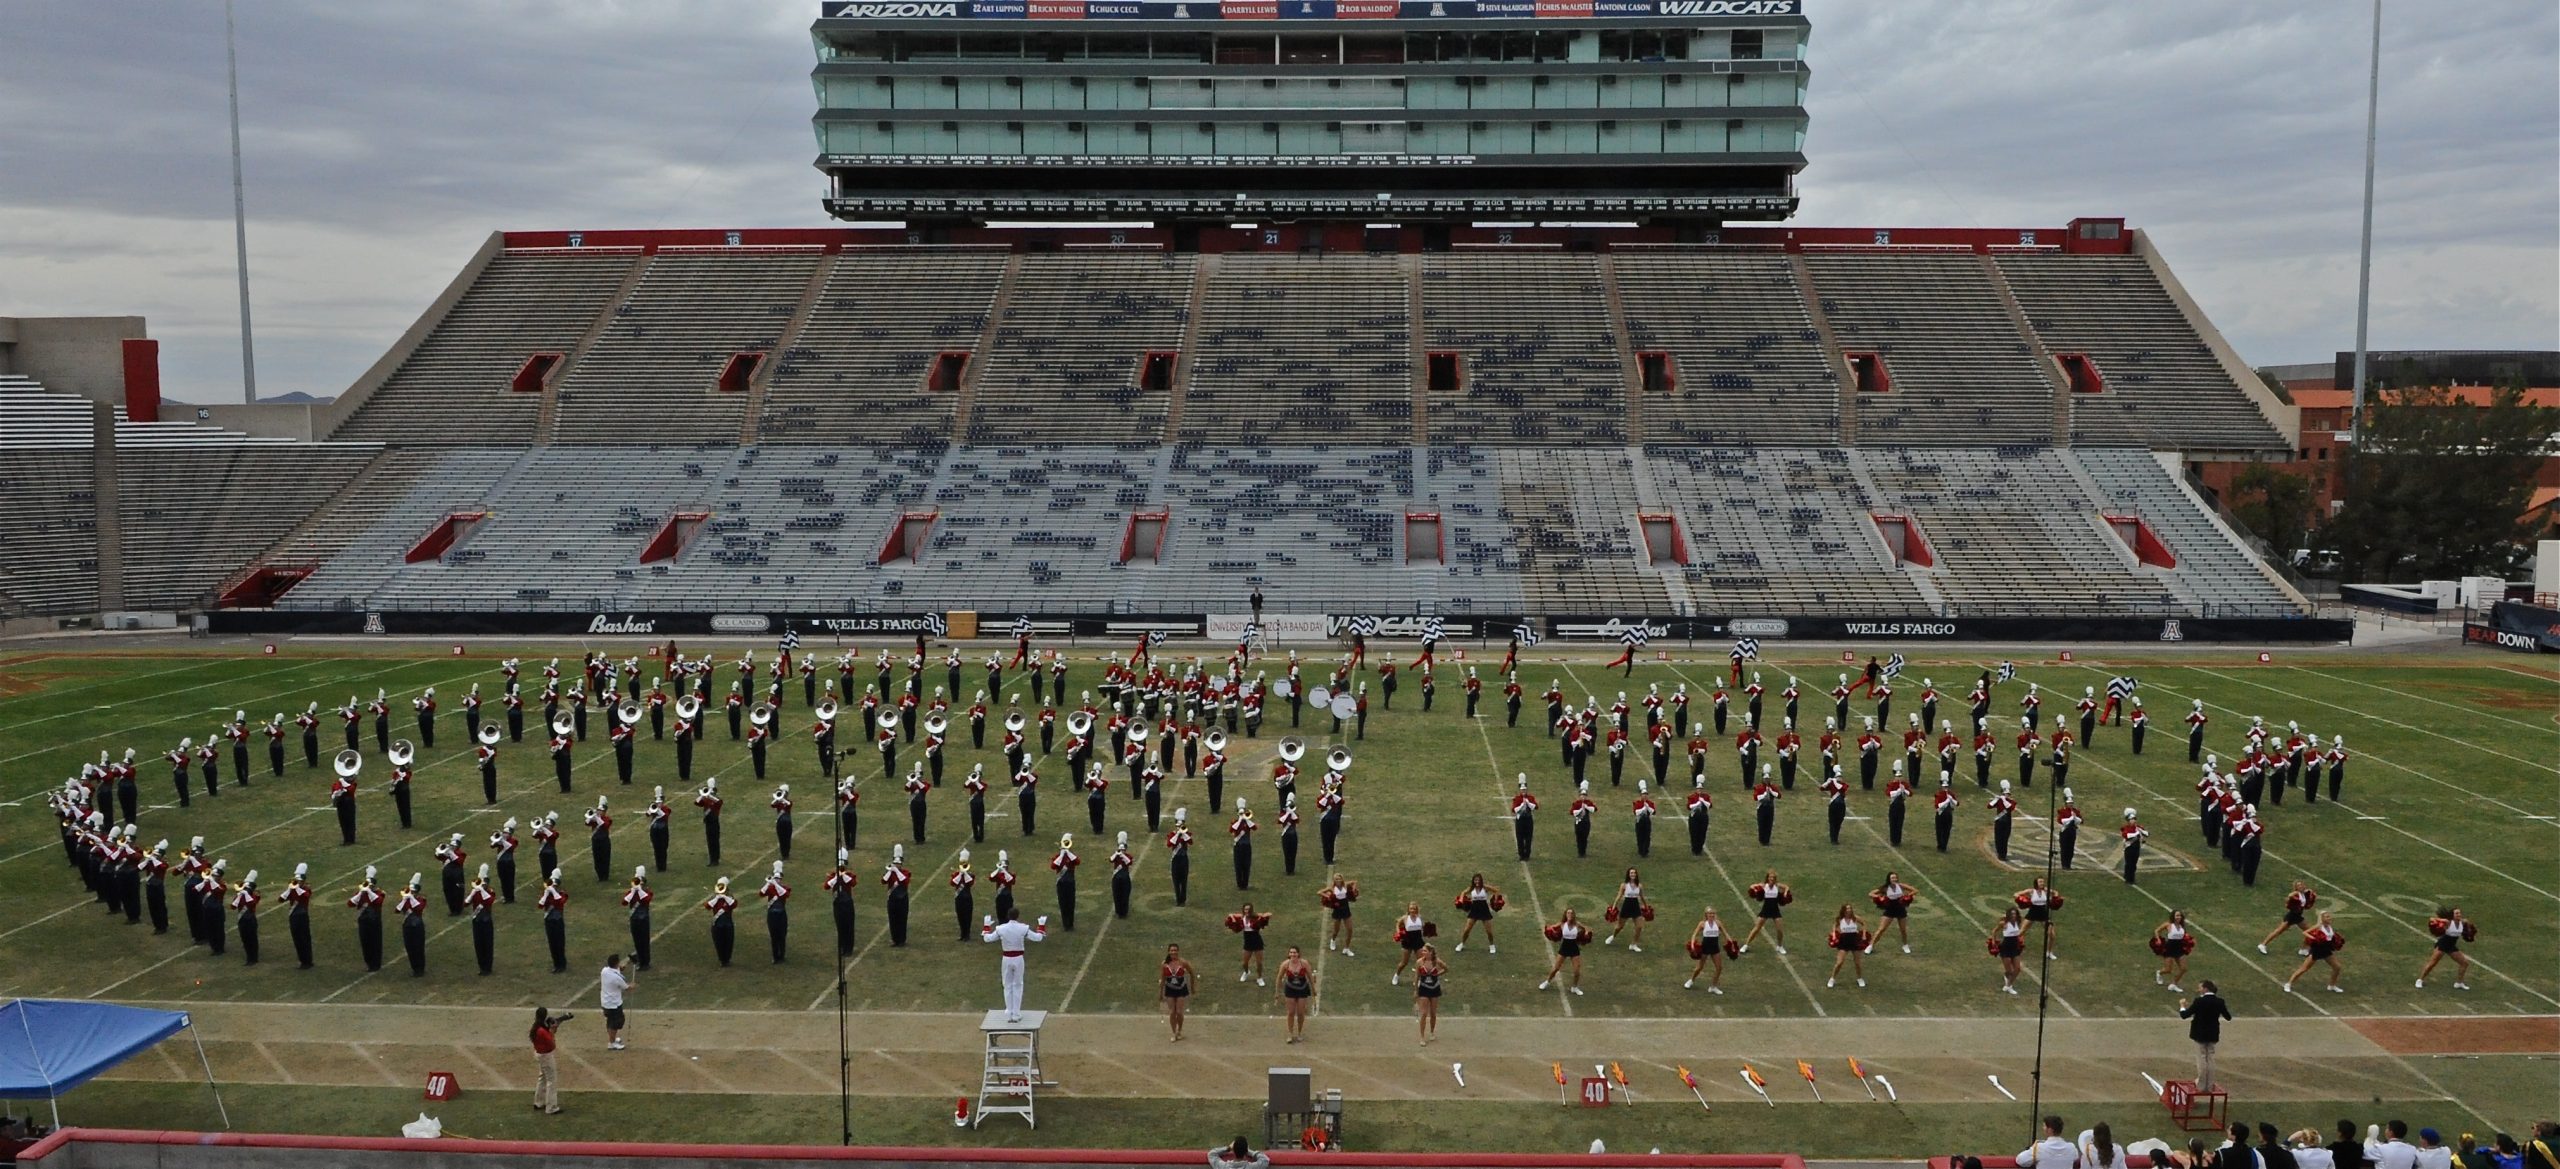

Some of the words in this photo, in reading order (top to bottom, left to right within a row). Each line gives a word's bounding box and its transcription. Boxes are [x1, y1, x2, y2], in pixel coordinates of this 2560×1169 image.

[836, 4, 957, 17] ARIZONA
[973, 4, 981, 12] 22
[1659, 1, 1794, 15] WILDCATS
[570, 238, 581, 247] 17
[728, 236, 739, 246] 18
[908, 235, 919, 244] 19
[1112, 235, 1124, 244] 20
[1266, 234, 1278, 244] 21
[1499, 234, 1512, 244] 22
[1706, 234, 1719, 244] 23
[1876, 235, 1888, 245] 24
[2020, 236, 2034, 246] 25
[198, 409, 209, 418] 16
[588, 614, 656, 634] Bashas'
[826, 619, 880, 630] WELLS
[1210, 622, 1246, 632] UNIVERSITY
[1290, 622, 1309, 632] BAND
[1310, 622, 1324, 632] DAY
[1845, 623, 1900, 634] WELLS
[1903, 624, 1956, 634] FARGO
[428, 1076, 446, 1096] 40
[1010, 1079, 1024, 1096] 50
[1585, 1082, 1604, 1102] 40
